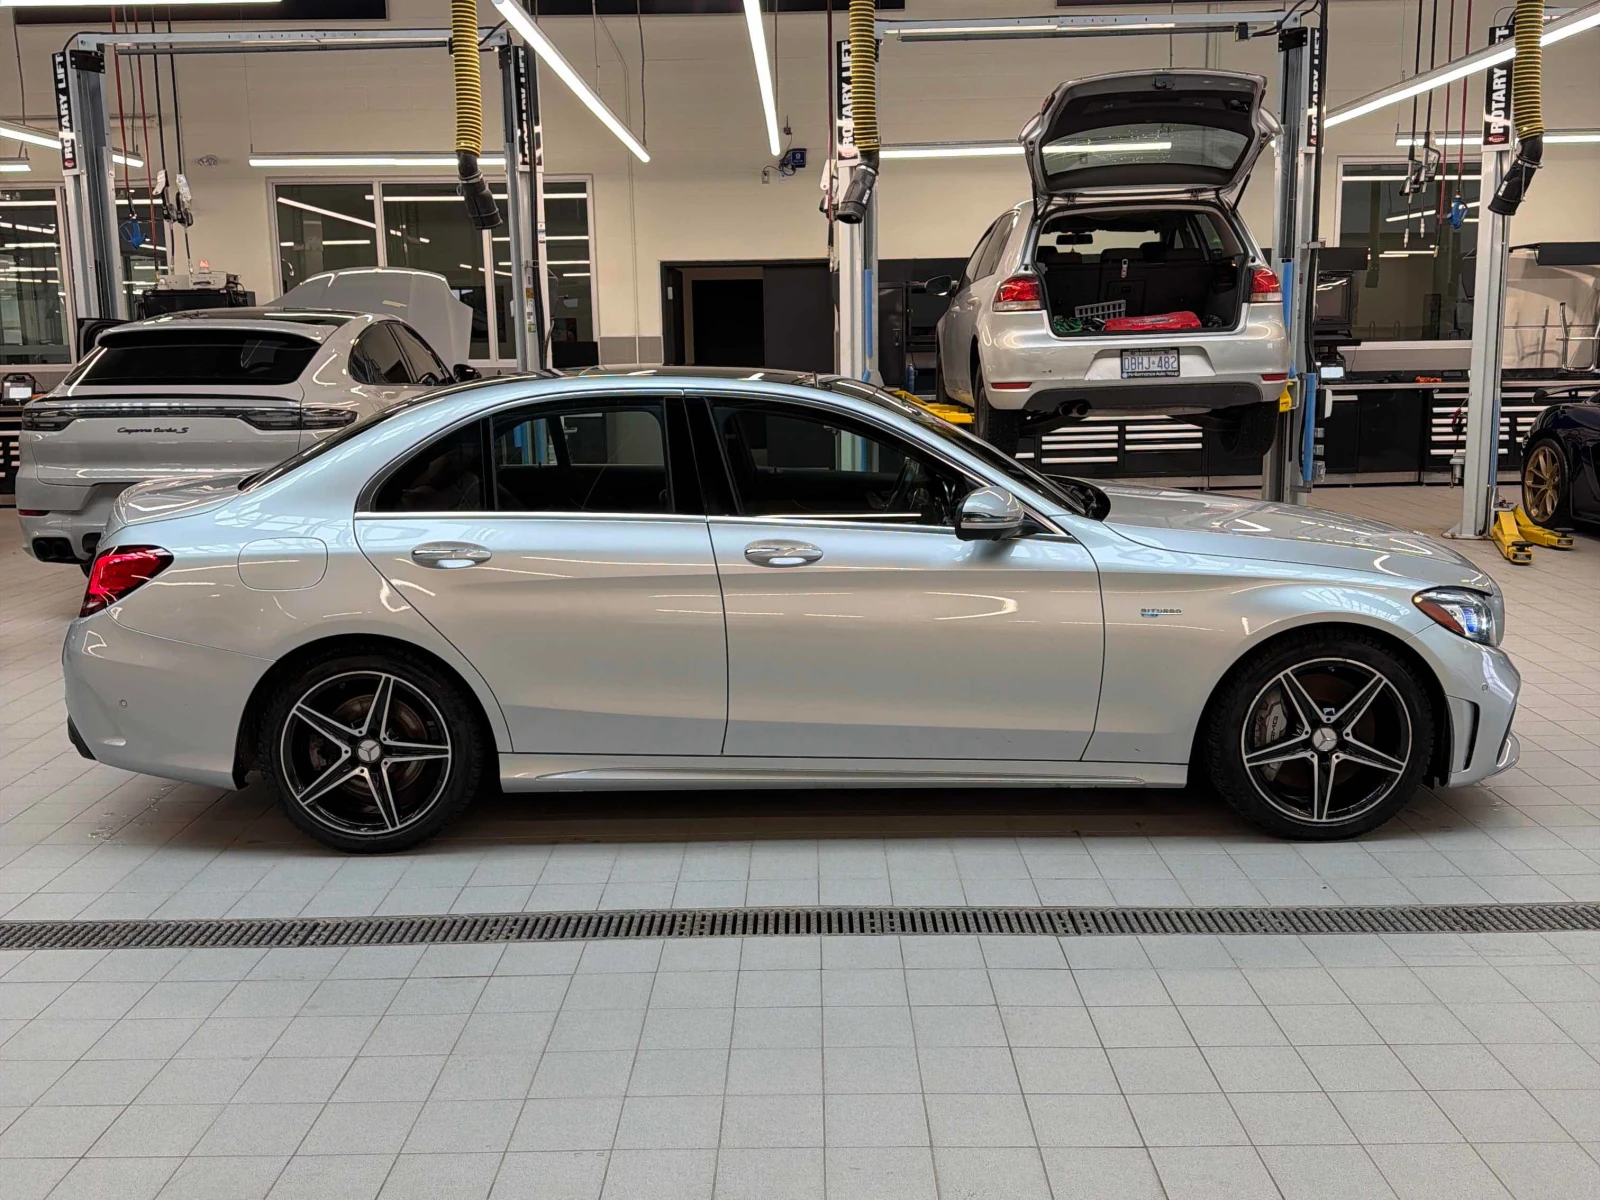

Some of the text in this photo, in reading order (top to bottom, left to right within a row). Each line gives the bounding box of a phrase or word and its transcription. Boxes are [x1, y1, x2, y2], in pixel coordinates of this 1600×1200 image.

[55, 54, 73, 159] ROTARY LIFT
[1491, 68, 1507, 133] ROTARY
[1123, 355, 1177, 371] DBHJ 482
[117, 427, 152, 435] Cayenne
